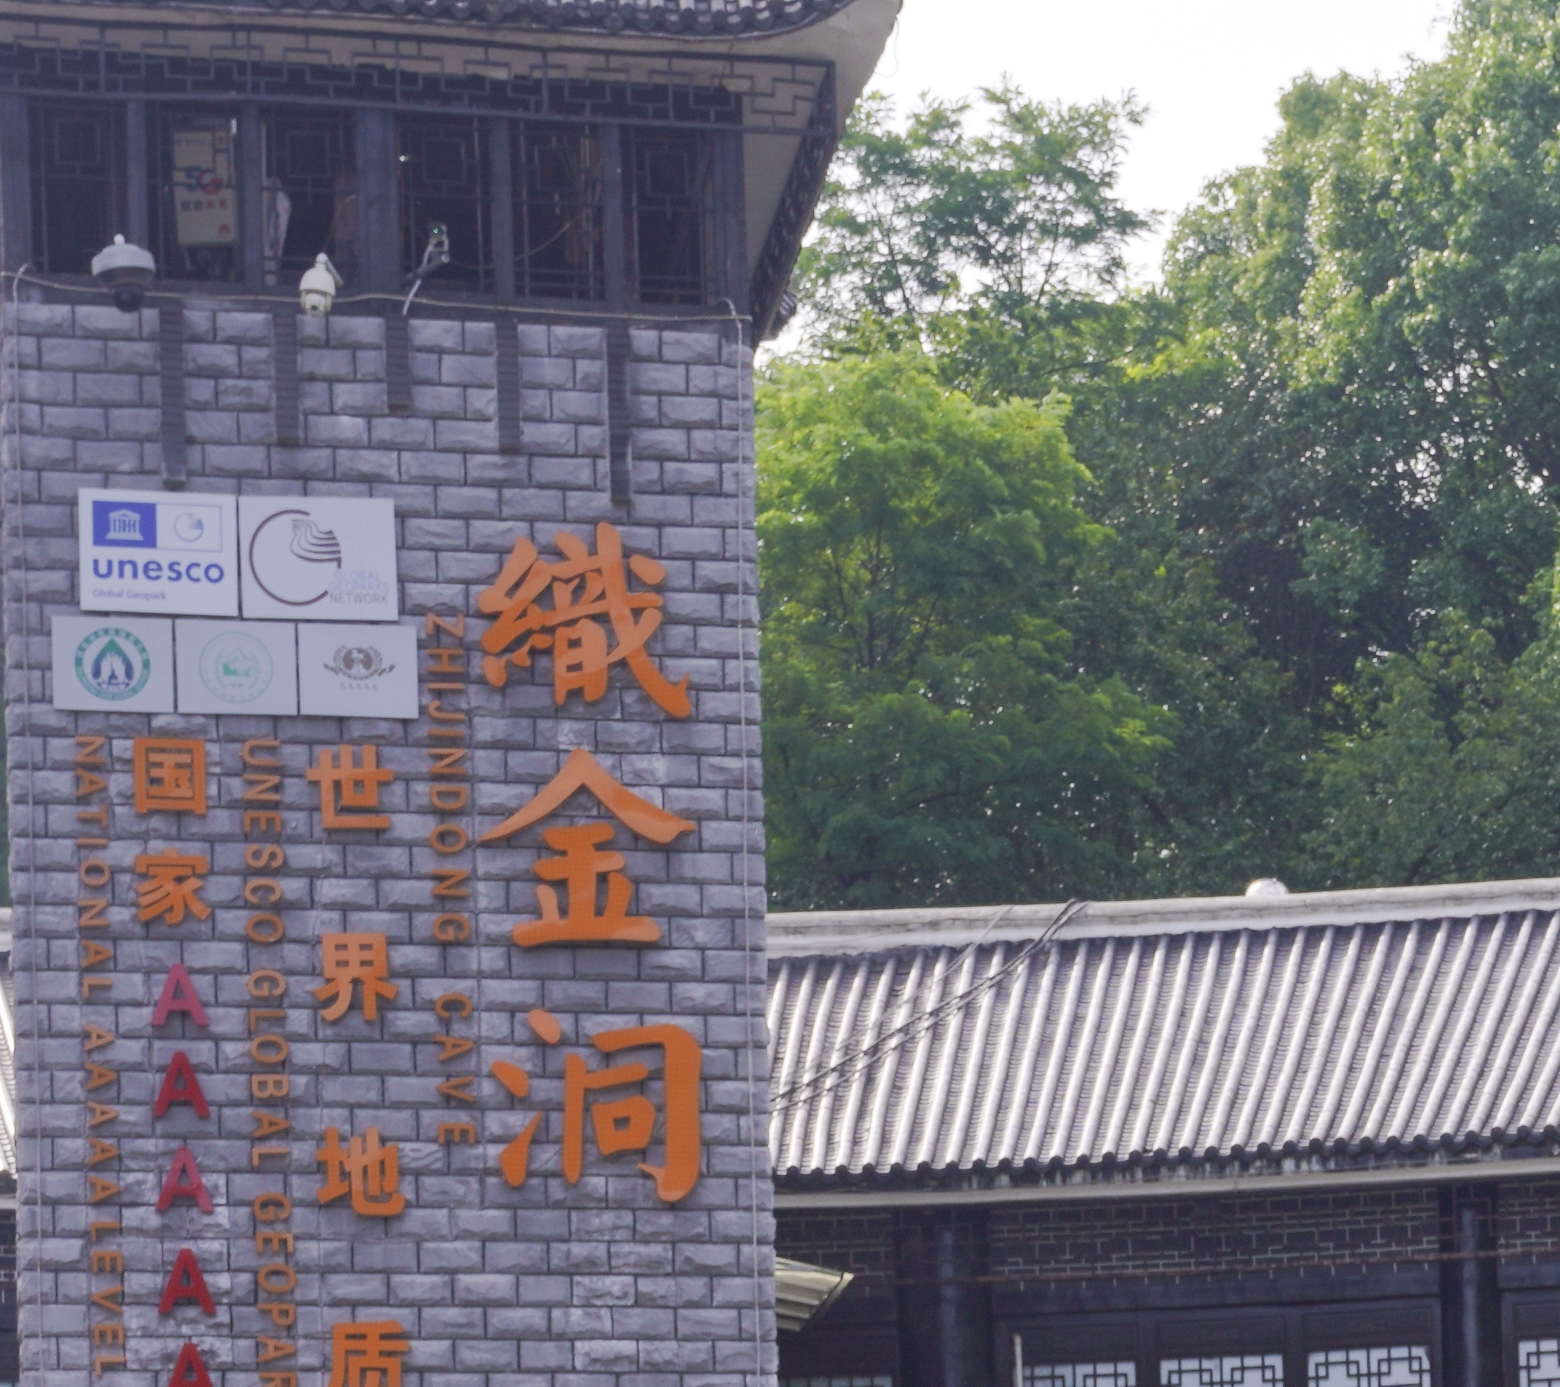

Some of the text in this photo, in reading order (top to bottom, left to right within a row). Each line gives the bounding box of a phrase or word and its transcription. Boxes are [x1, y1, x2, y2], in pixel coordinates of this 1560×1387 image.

[93, 557, 225, 584] unesco
[329, 592, 390, 606] NETWORK
[334, 569, 381, 582] GLOBAL
[75, 734, 112, 998] NATIONAL
[241, 739, 285, 944] UNESCO
[426, 612, 476, 1146] ZHIJINDONG CAVE
[478, 522, 704, 1205] 織金洞
[83, 1025, 120, 1204] AAAAA
[246, 969, 290, 1168] GLOBAL
[89, 1220, 126, 1376] LEVEL
